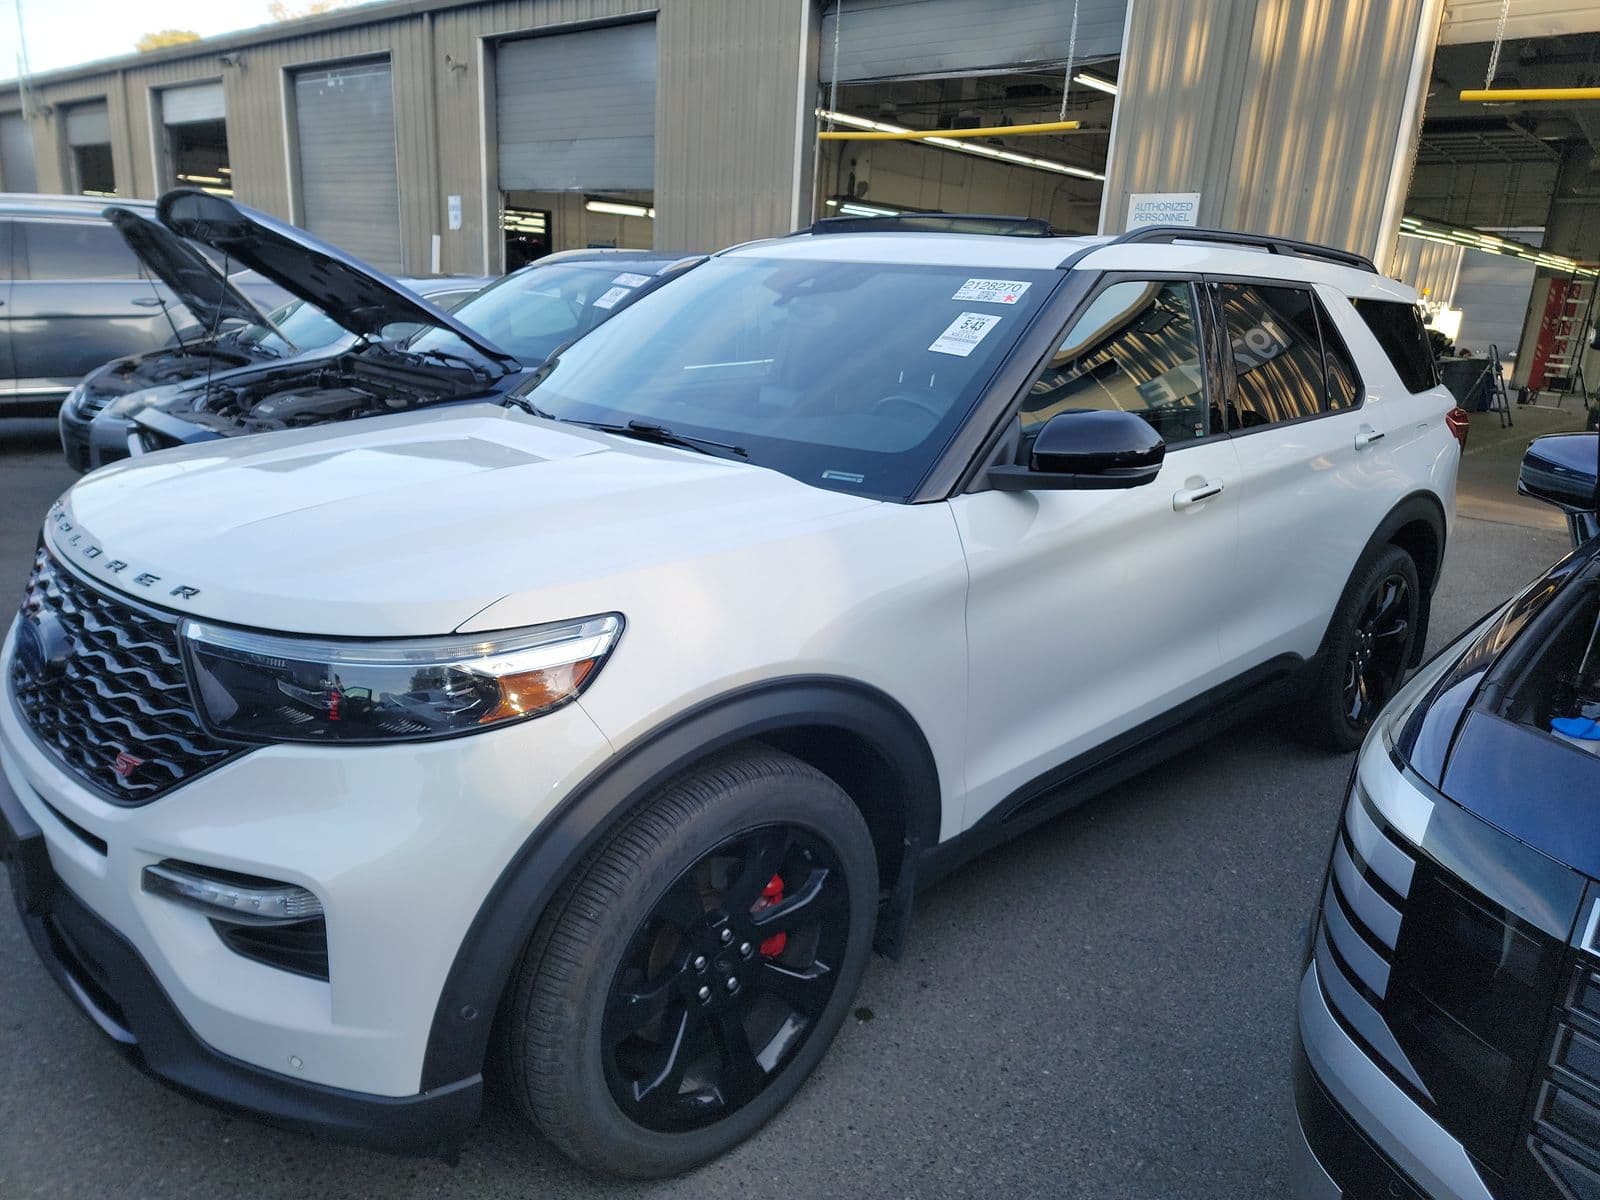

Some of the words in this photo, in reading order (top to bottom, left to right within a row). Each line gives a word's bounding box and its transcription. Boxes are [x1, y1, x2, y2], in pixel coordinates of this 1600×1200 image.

[1134, 202, 1194, 212] AUTHORIZED
[1133, 212, 1190, 222] PERSONNEL
[963, 280, 1023, 293] 2128270
